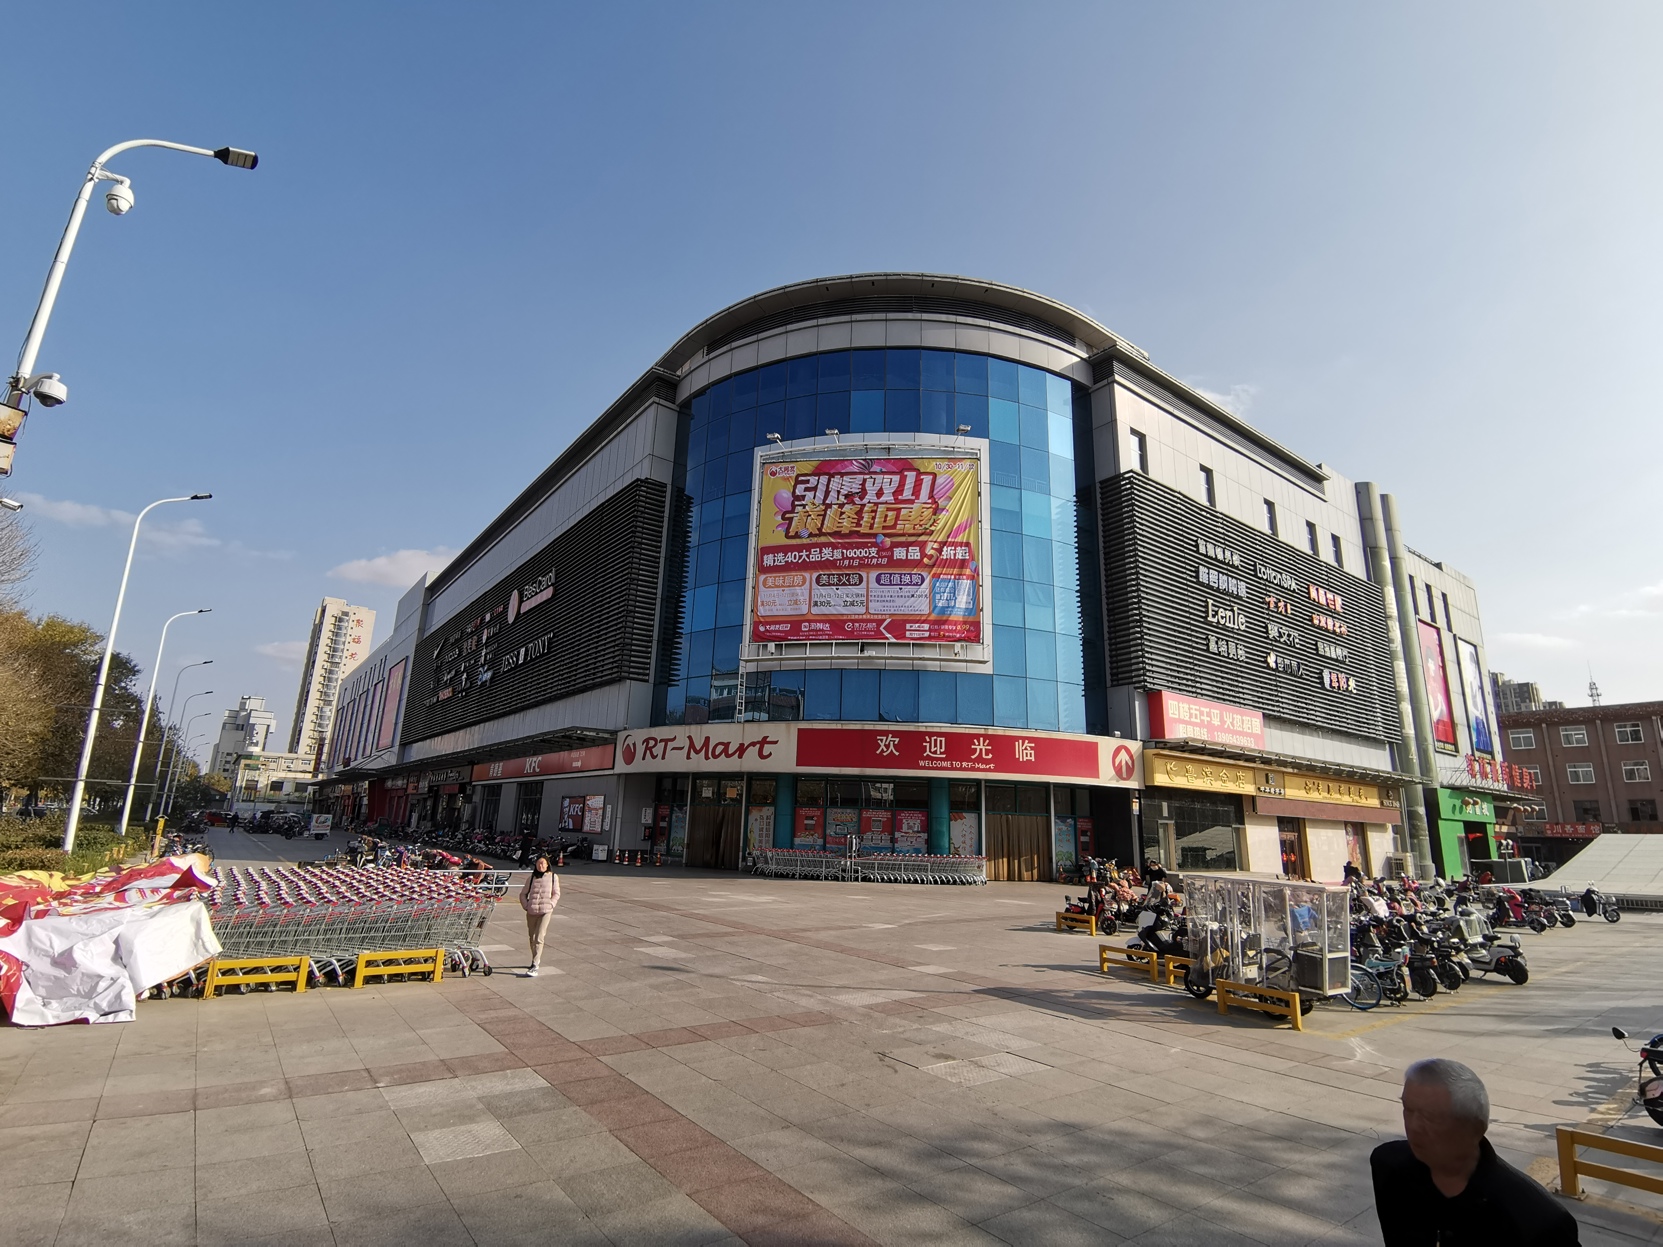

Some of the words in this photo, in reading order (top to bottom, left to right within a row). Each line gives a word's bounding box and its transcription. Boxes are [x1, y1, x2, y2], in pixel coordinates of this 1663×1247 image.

[795, 471, 933, 505] 引爆双11
[784, 502, 937, 536] 巅峰钜惠
[762, 547, 878, 568] 精选40大品类超10000支
[765, 575, 804, 588] 美味厨房
[819, 573, 860, 586] 美味火锅
[880, 573, 922, 585] 超值换购
[842, 600, 866, 608] 立减5元
[1168, 700, 1221, 727] 四楼五千平
[1223, 711, 1262, 735] 火热招商
[641, 734, 780, 761] RT-Mart
[875, 733, 1036, 762] 欢迎光临
[524, 756, 542, 774] KFC
[918, 759, 951, 769] WELCOME
[952, 760, 961, 769] TO
[961, 761, 996, 770] RT-Mart
[569, 803, 583, 816] KFC
